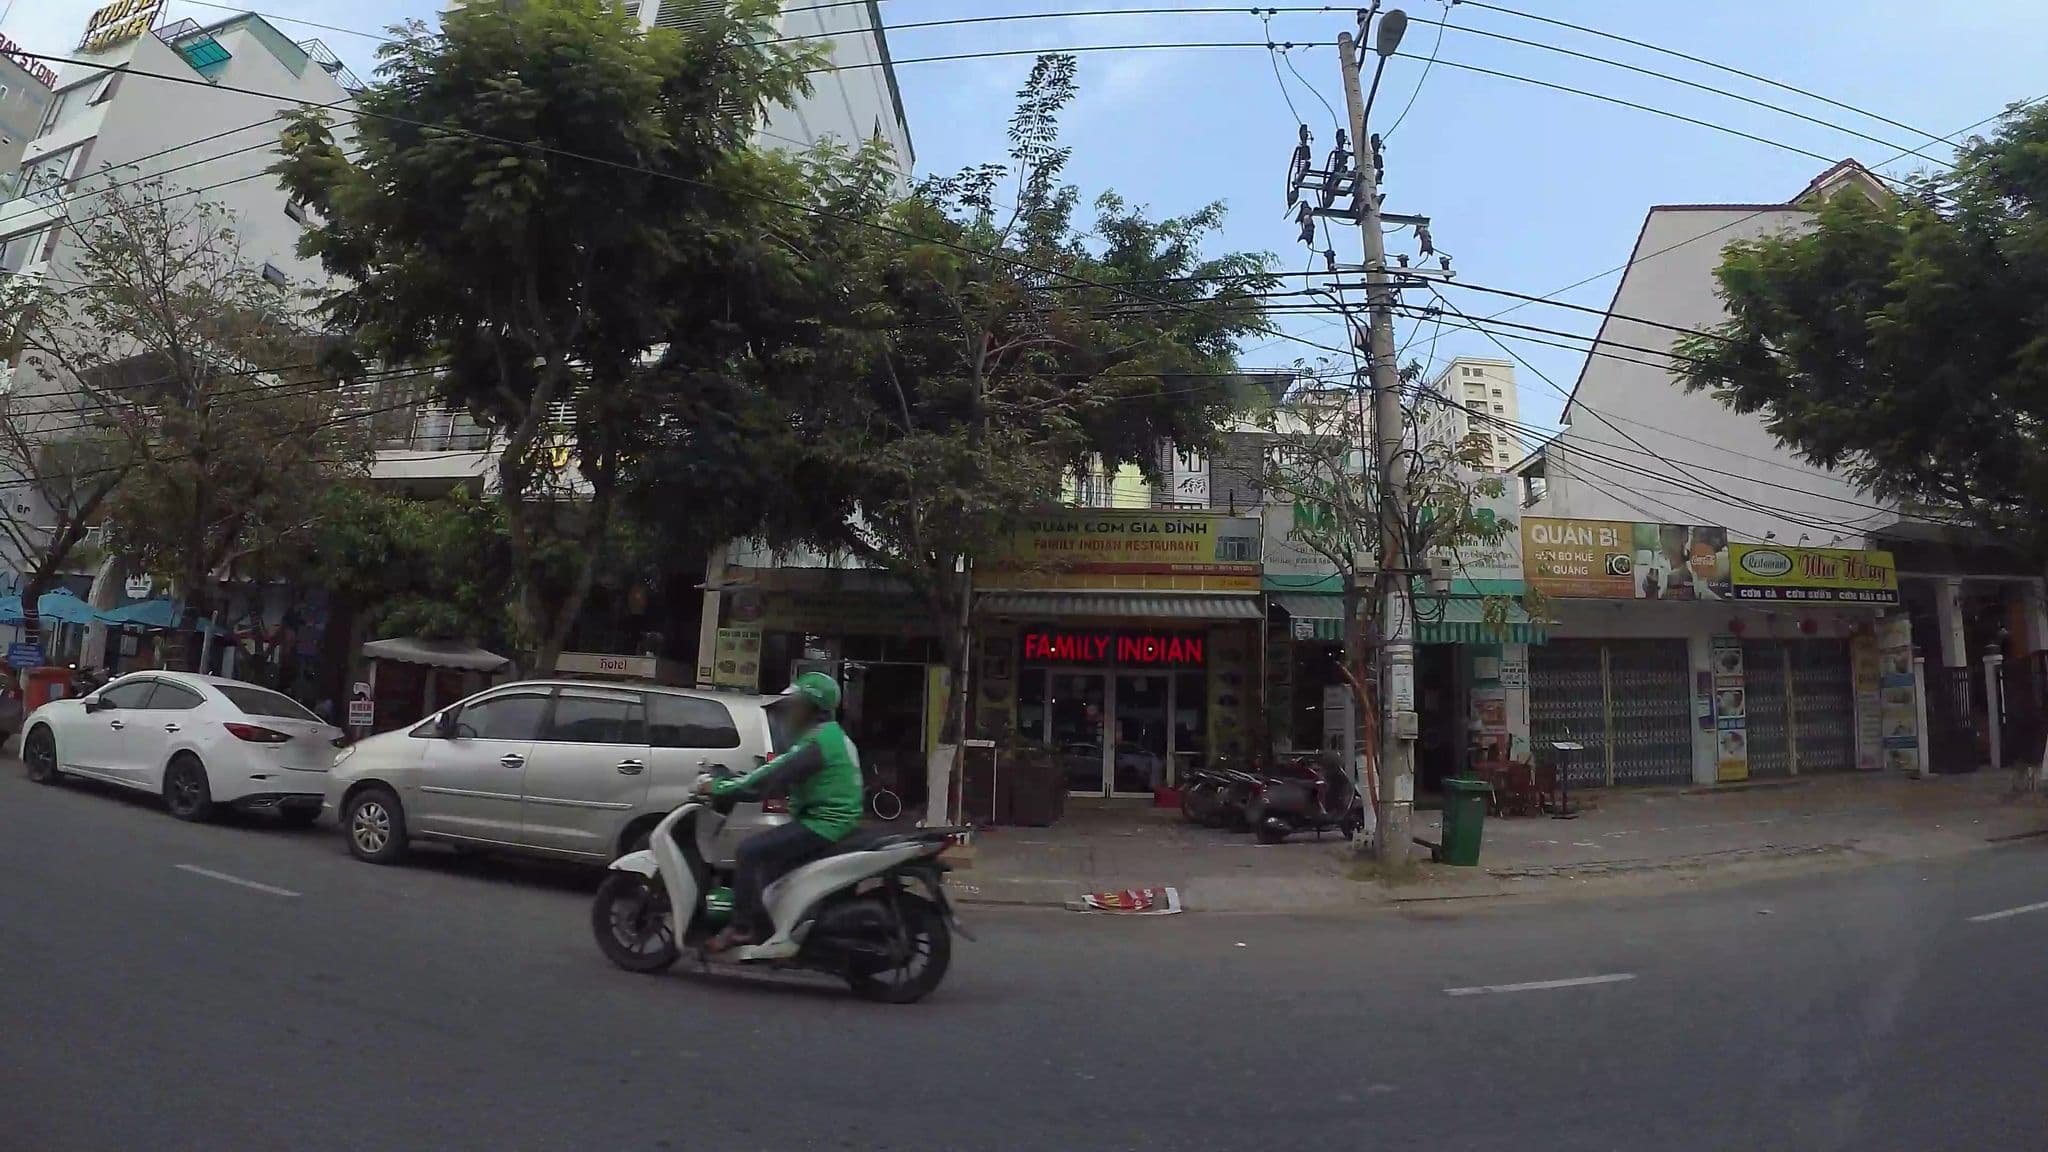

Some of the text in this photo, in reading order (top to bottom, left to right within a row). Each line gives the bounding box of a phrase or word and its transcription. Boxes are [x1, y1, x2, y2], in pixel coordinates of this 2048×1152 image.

[1130, 522, 1159, 533] GIA
[1532, 522, 1593, 546] QUÁN
[1080, 540, 1120, 550] INDIAN
[1125, 540, 1200, 551] RESTAURANT
[1748, 557, 1788, 570] Restaurant
[1025, 634, 1202, 662] FAMILY INDIAN
[600, 658, 627, 670] hotel
